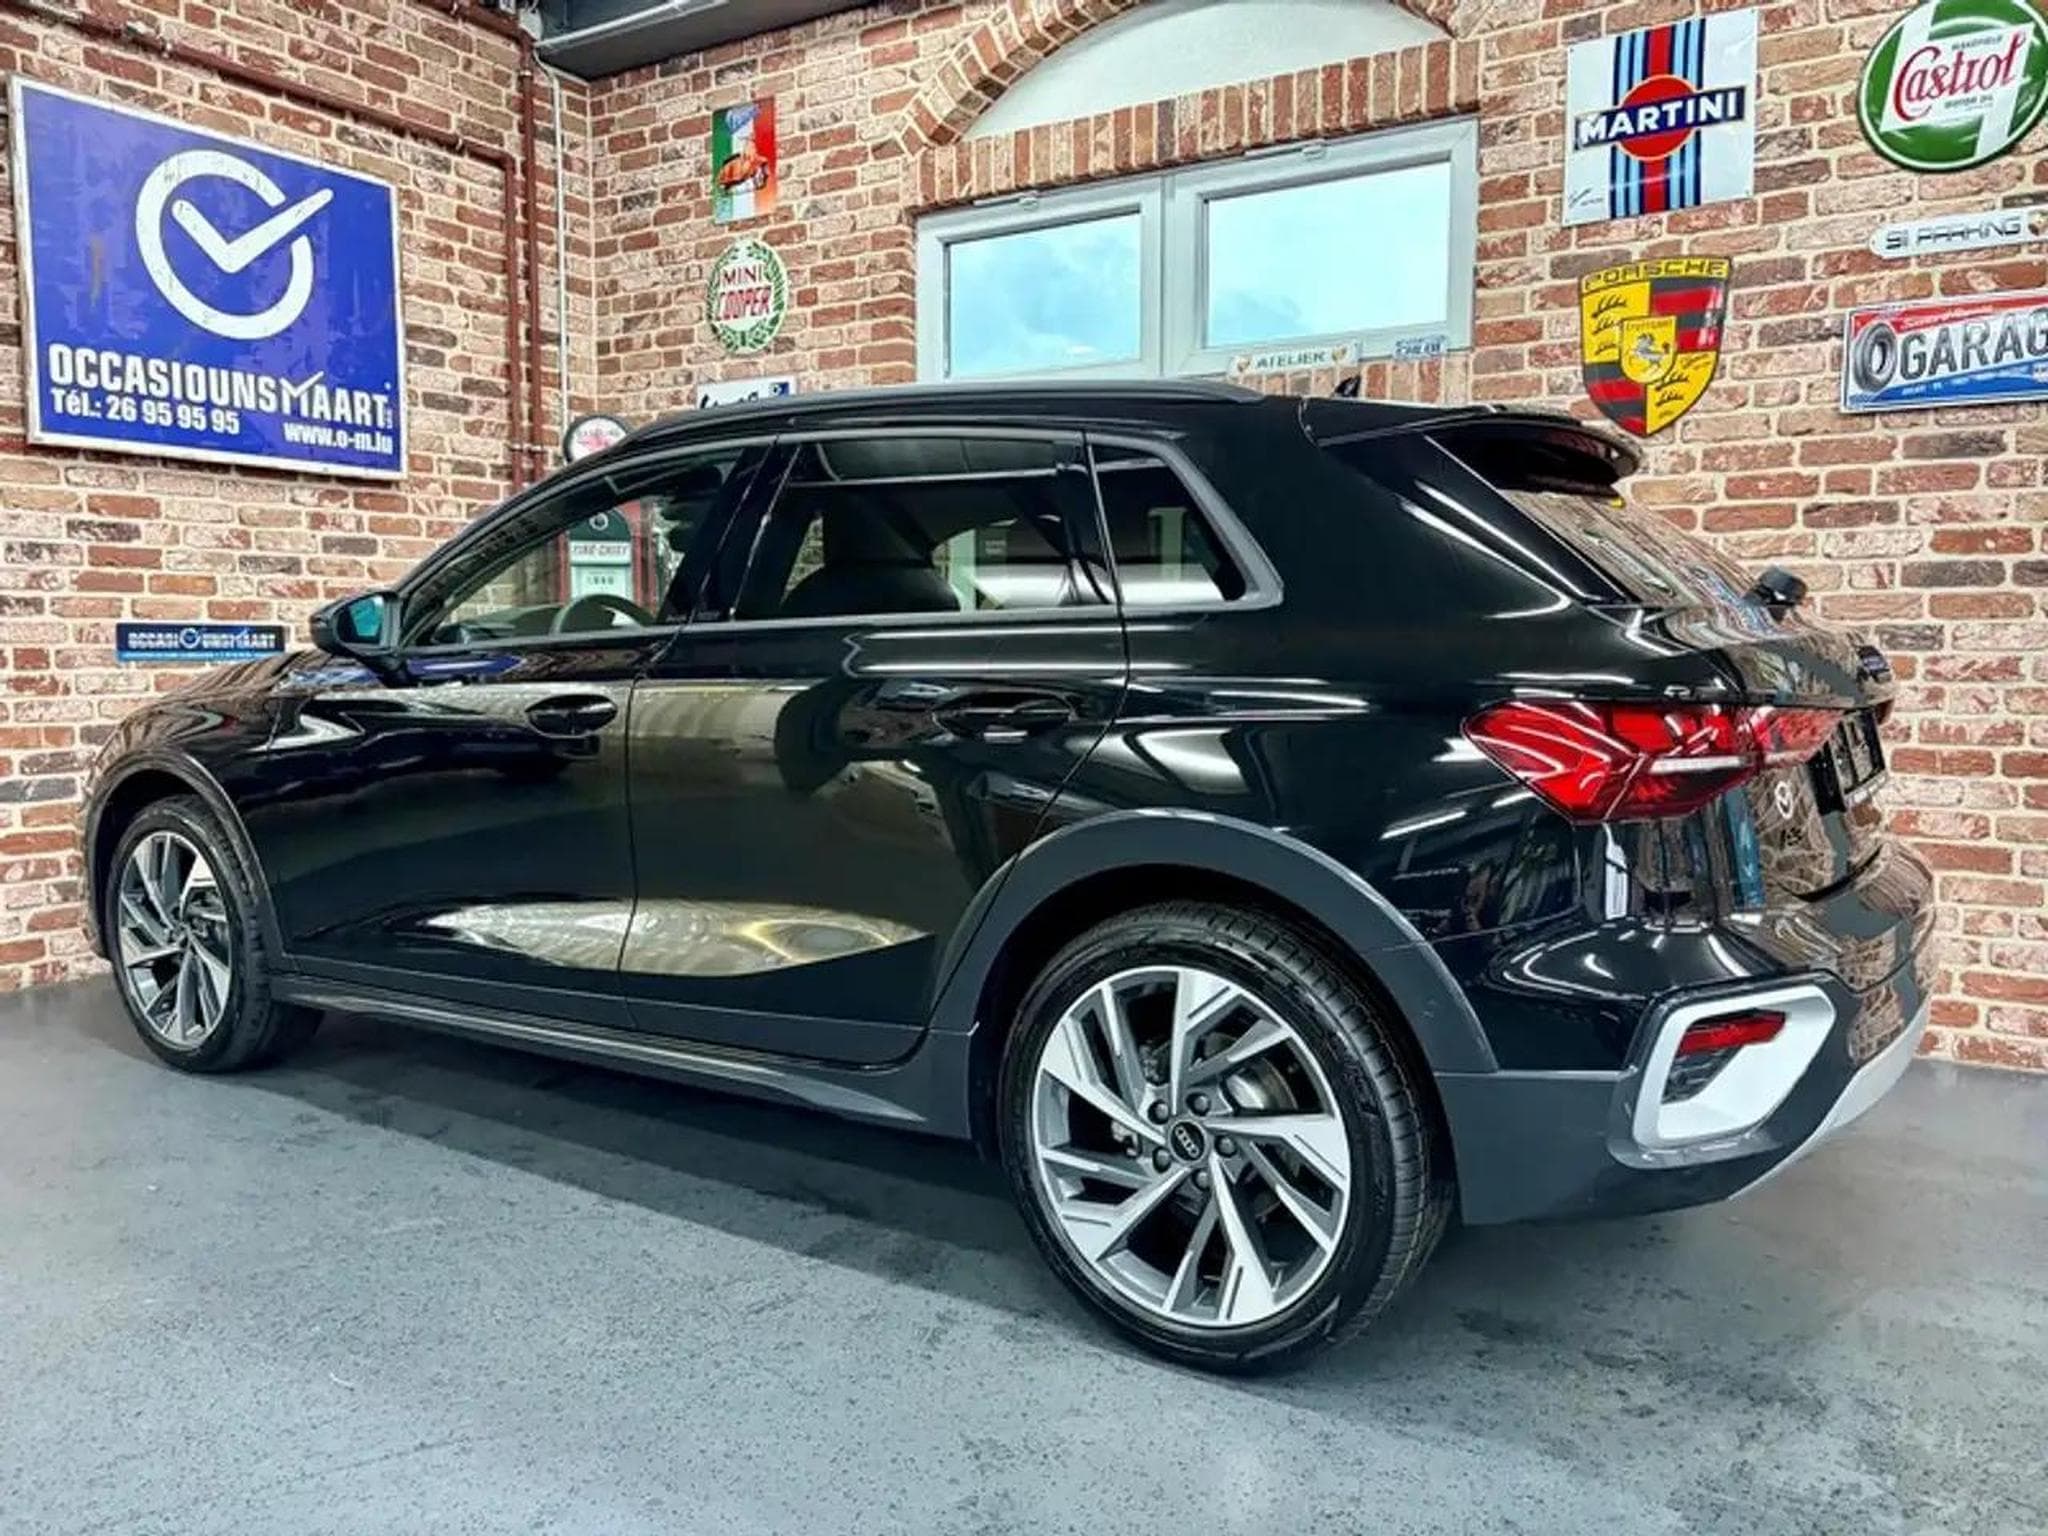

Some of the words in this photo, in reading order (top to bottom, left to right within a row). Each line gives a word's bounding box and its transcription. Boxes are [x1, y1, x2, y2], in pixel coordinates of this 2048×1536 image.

[1893, 30, 2025, 122] Castrol
[1579, 90, 1738, 145] MARTINI
[1917, 216, 2021, 243] PARKING
[722, 265, 763, 286] MINI
[1585, 260, 1726, 291] PORSCHE
[720, 286, 771, 321] COOPER
[1256, 351, 1326, 369] ATELIER
[49, 343, 389, 429] OCCASIOUNSMAART
[51, 387, 101, 418] Tél.:
[105, 394, 138, 422] 26
[142, 400, 173, 427] 95
[177, 404, 207, 431] 95
[211, 409, 240, 435] 95
[283, 422, 394, 455] www.o-m.lu
